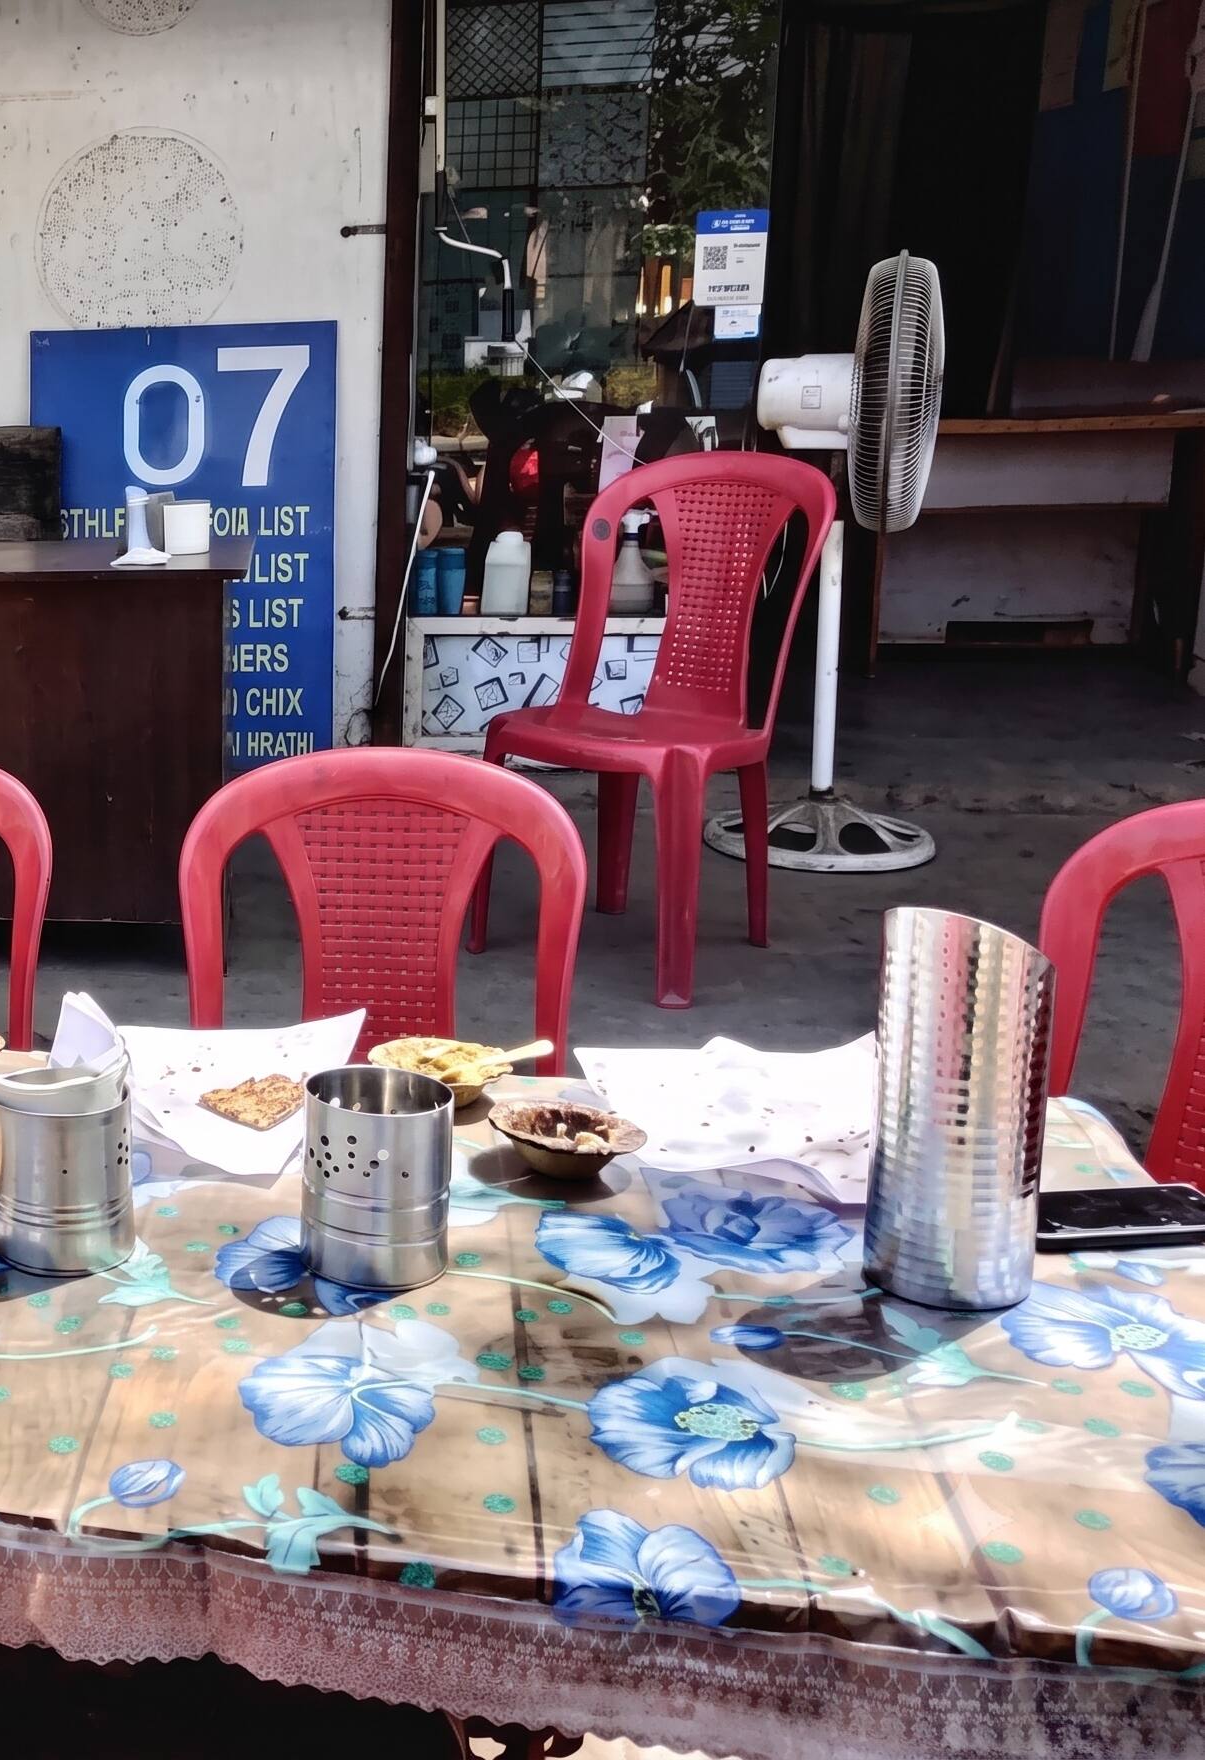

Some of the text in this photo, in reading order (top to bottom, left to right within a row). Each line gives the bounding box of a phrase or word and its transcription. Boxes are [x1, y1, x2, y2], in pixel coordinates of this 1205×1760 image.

[123, 344, 310, 487] 07
[209, 507, 249, 537] OIA
[259, 505, 310, 536] LIST
[254, 552, 310, 583] LIST
[249, 598, 304, 628] LIST
[245, 687, 304, 716] CHIX
[247, 731, 314, 757] HRATHI
